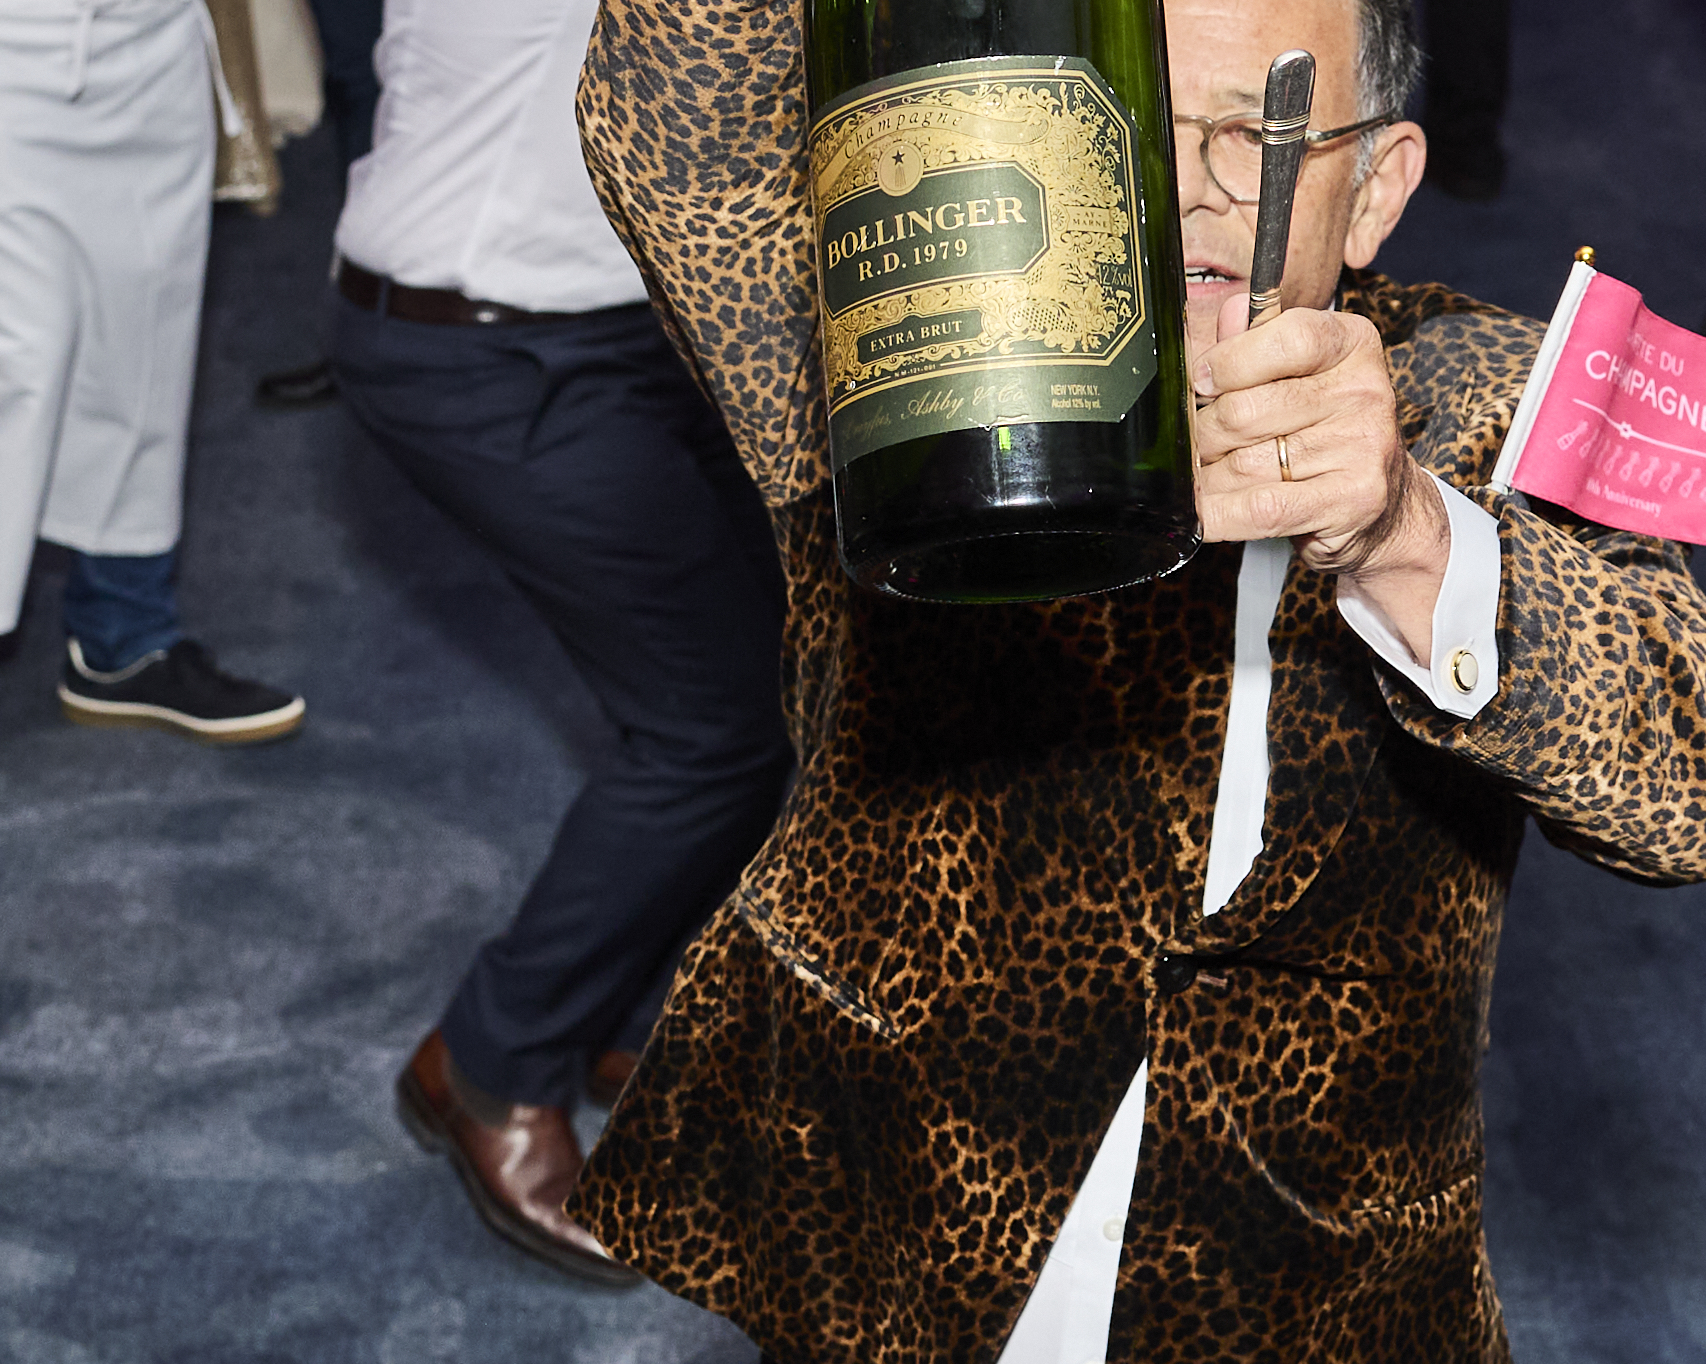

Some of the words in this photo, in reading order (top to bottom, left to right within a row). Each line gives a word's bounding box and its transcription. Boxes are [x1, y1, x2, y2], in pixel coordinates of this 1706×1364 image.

[844, 111, 963, 159] Champagne
[827, 196, 1027, 270] BOLLINGER
[1072, 218, 1108, 229] MARNE
[858, 252, 907, 282] R.D.
[913, 238, 968, 266] 1979
[870, 330, 915, 353] EXTRA
[920, 320, 963, 339] BRUT
[1659, 351, 1685, 377] DU
[901, 390, 965, 420] Ashby
[1050, 384, 1067, 396] NEW
[1067, 384, 1086, 396] YORK
